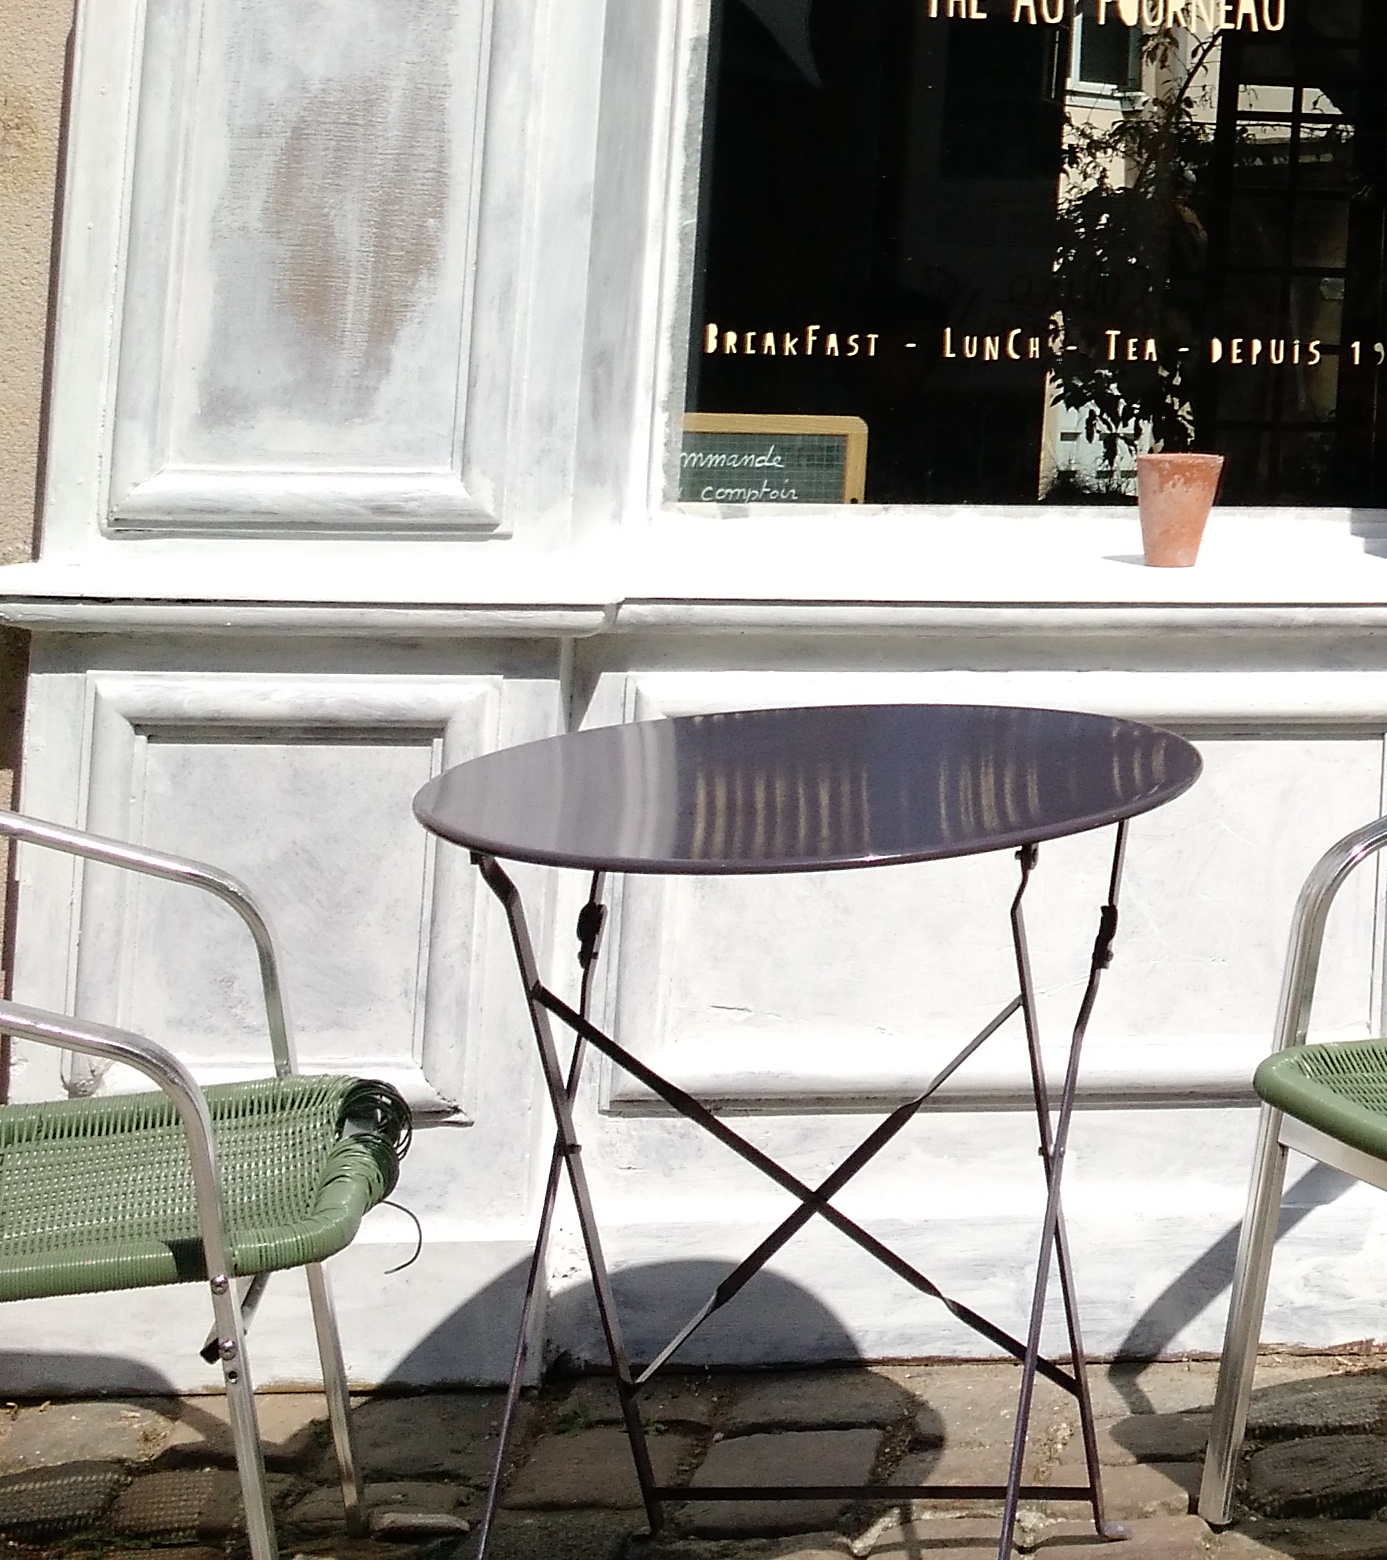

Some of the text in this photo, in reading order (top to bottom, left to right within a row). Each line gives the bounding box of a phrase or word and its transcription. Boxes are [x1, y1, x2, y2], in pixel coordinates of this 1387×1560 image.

[705, 323, 878, 357] BREAKFAST
[944, 327, 1039, 360] LUNCH
[1105, 330, 1157, 361] TEA
[1211, 337, 1321, 366] DEPUIS
[680, 445, 785, 467] mmande
[701, 479, 798, 503] comptoir
